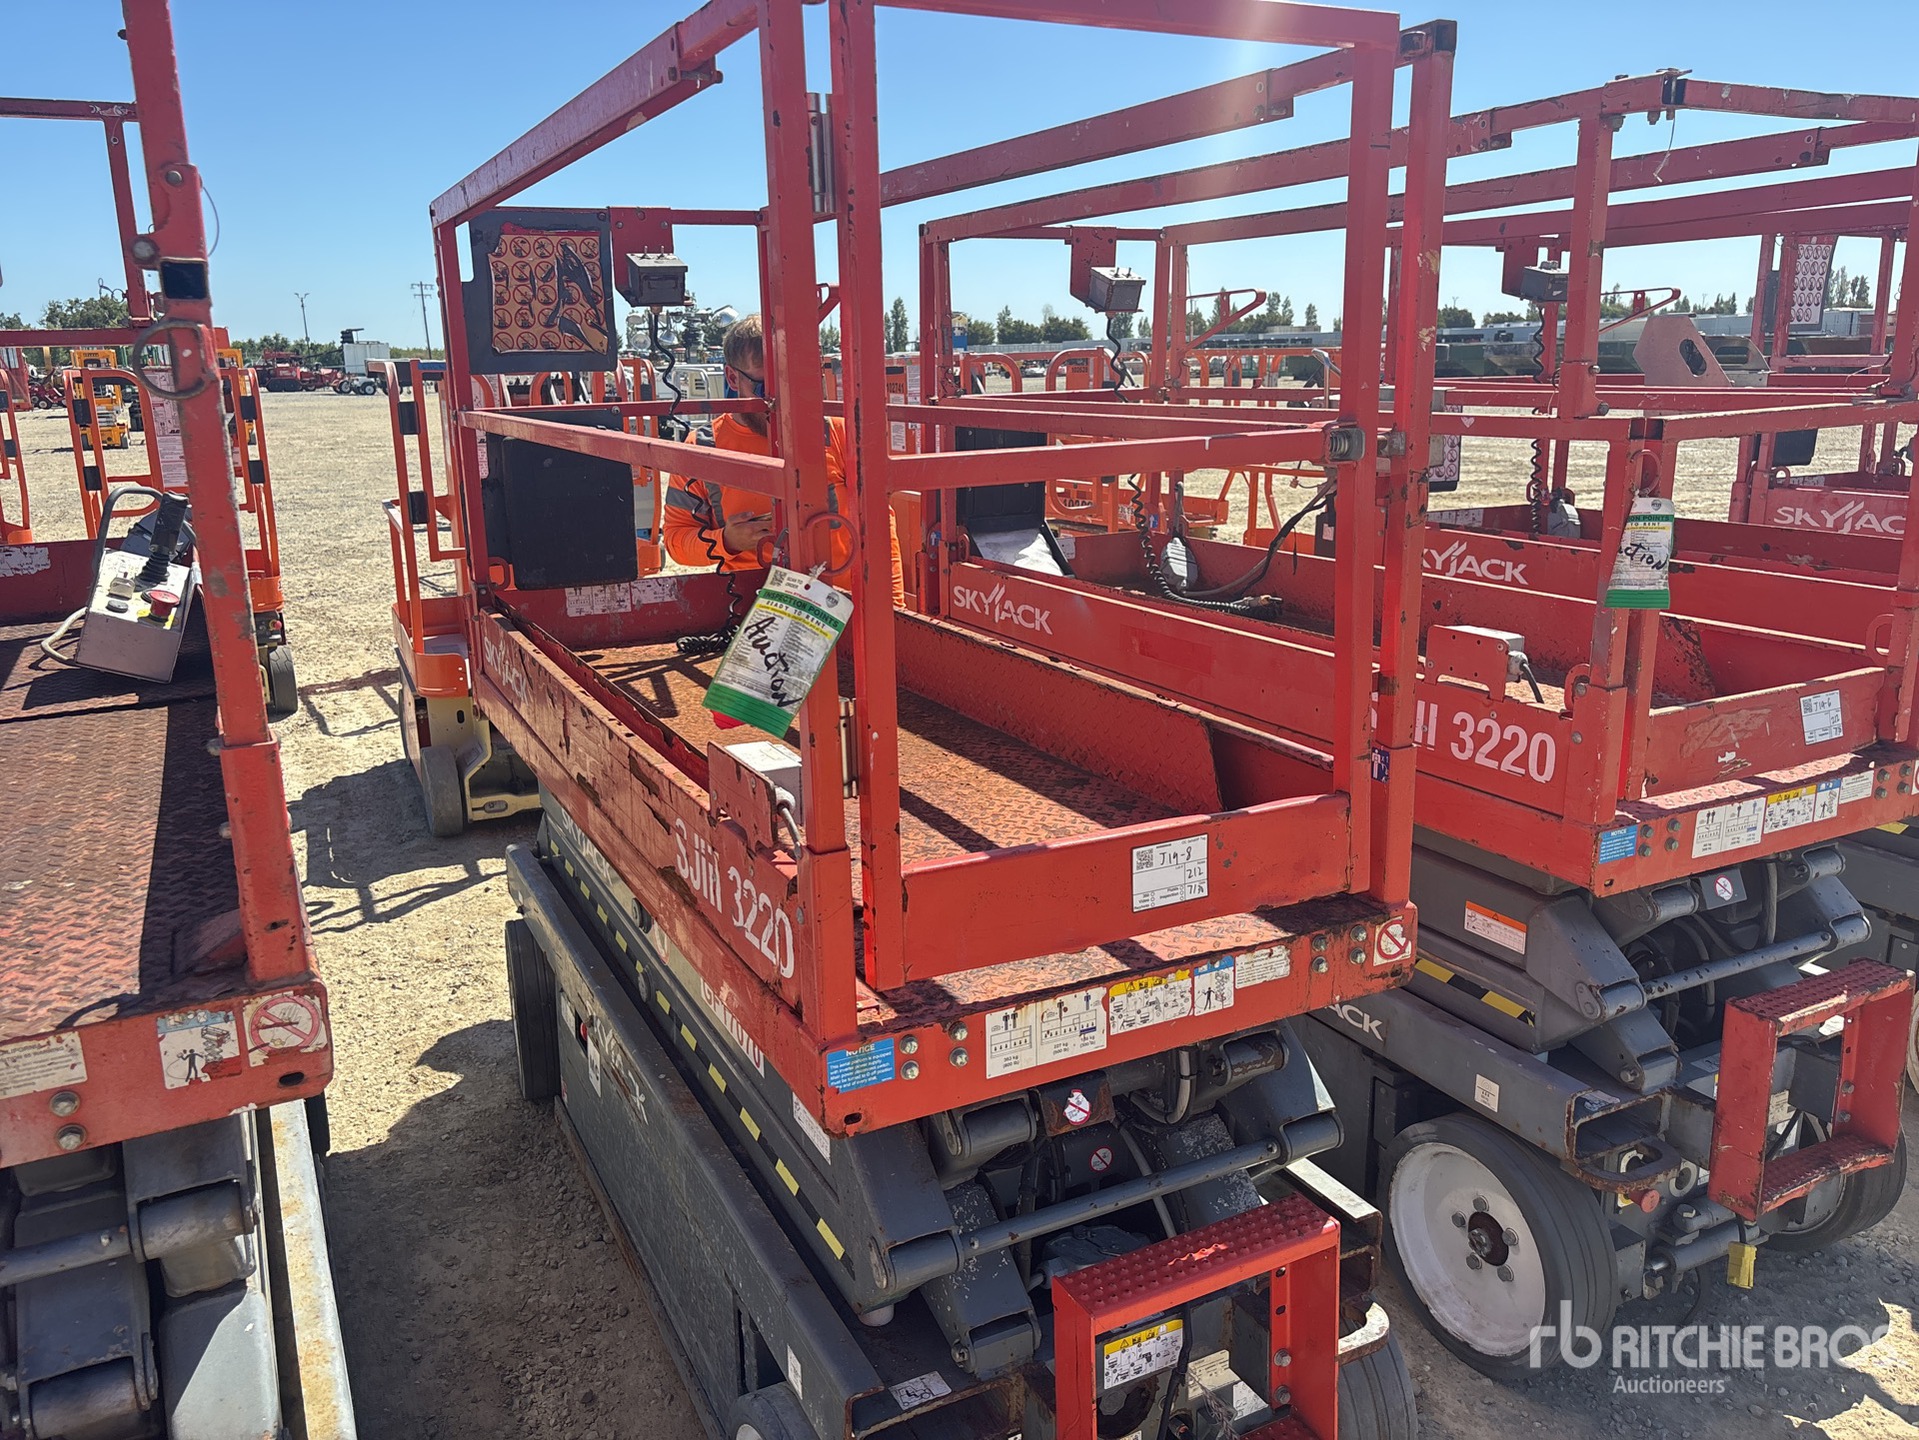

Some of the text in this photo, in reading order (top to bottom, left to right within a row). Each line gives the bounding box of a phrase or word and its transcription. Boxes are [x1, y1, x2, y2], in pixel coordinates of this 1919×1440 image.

[764, 591, 808, 610] INSPECTION
[808, 603, 840, 628] POINTS
[953, 583, 1053, 635] SKYJACK
[1450, 711, 1556, 783] 3220
[1186, 867, 1203, 879] 212
[728, 866, 794, 979] 3220
